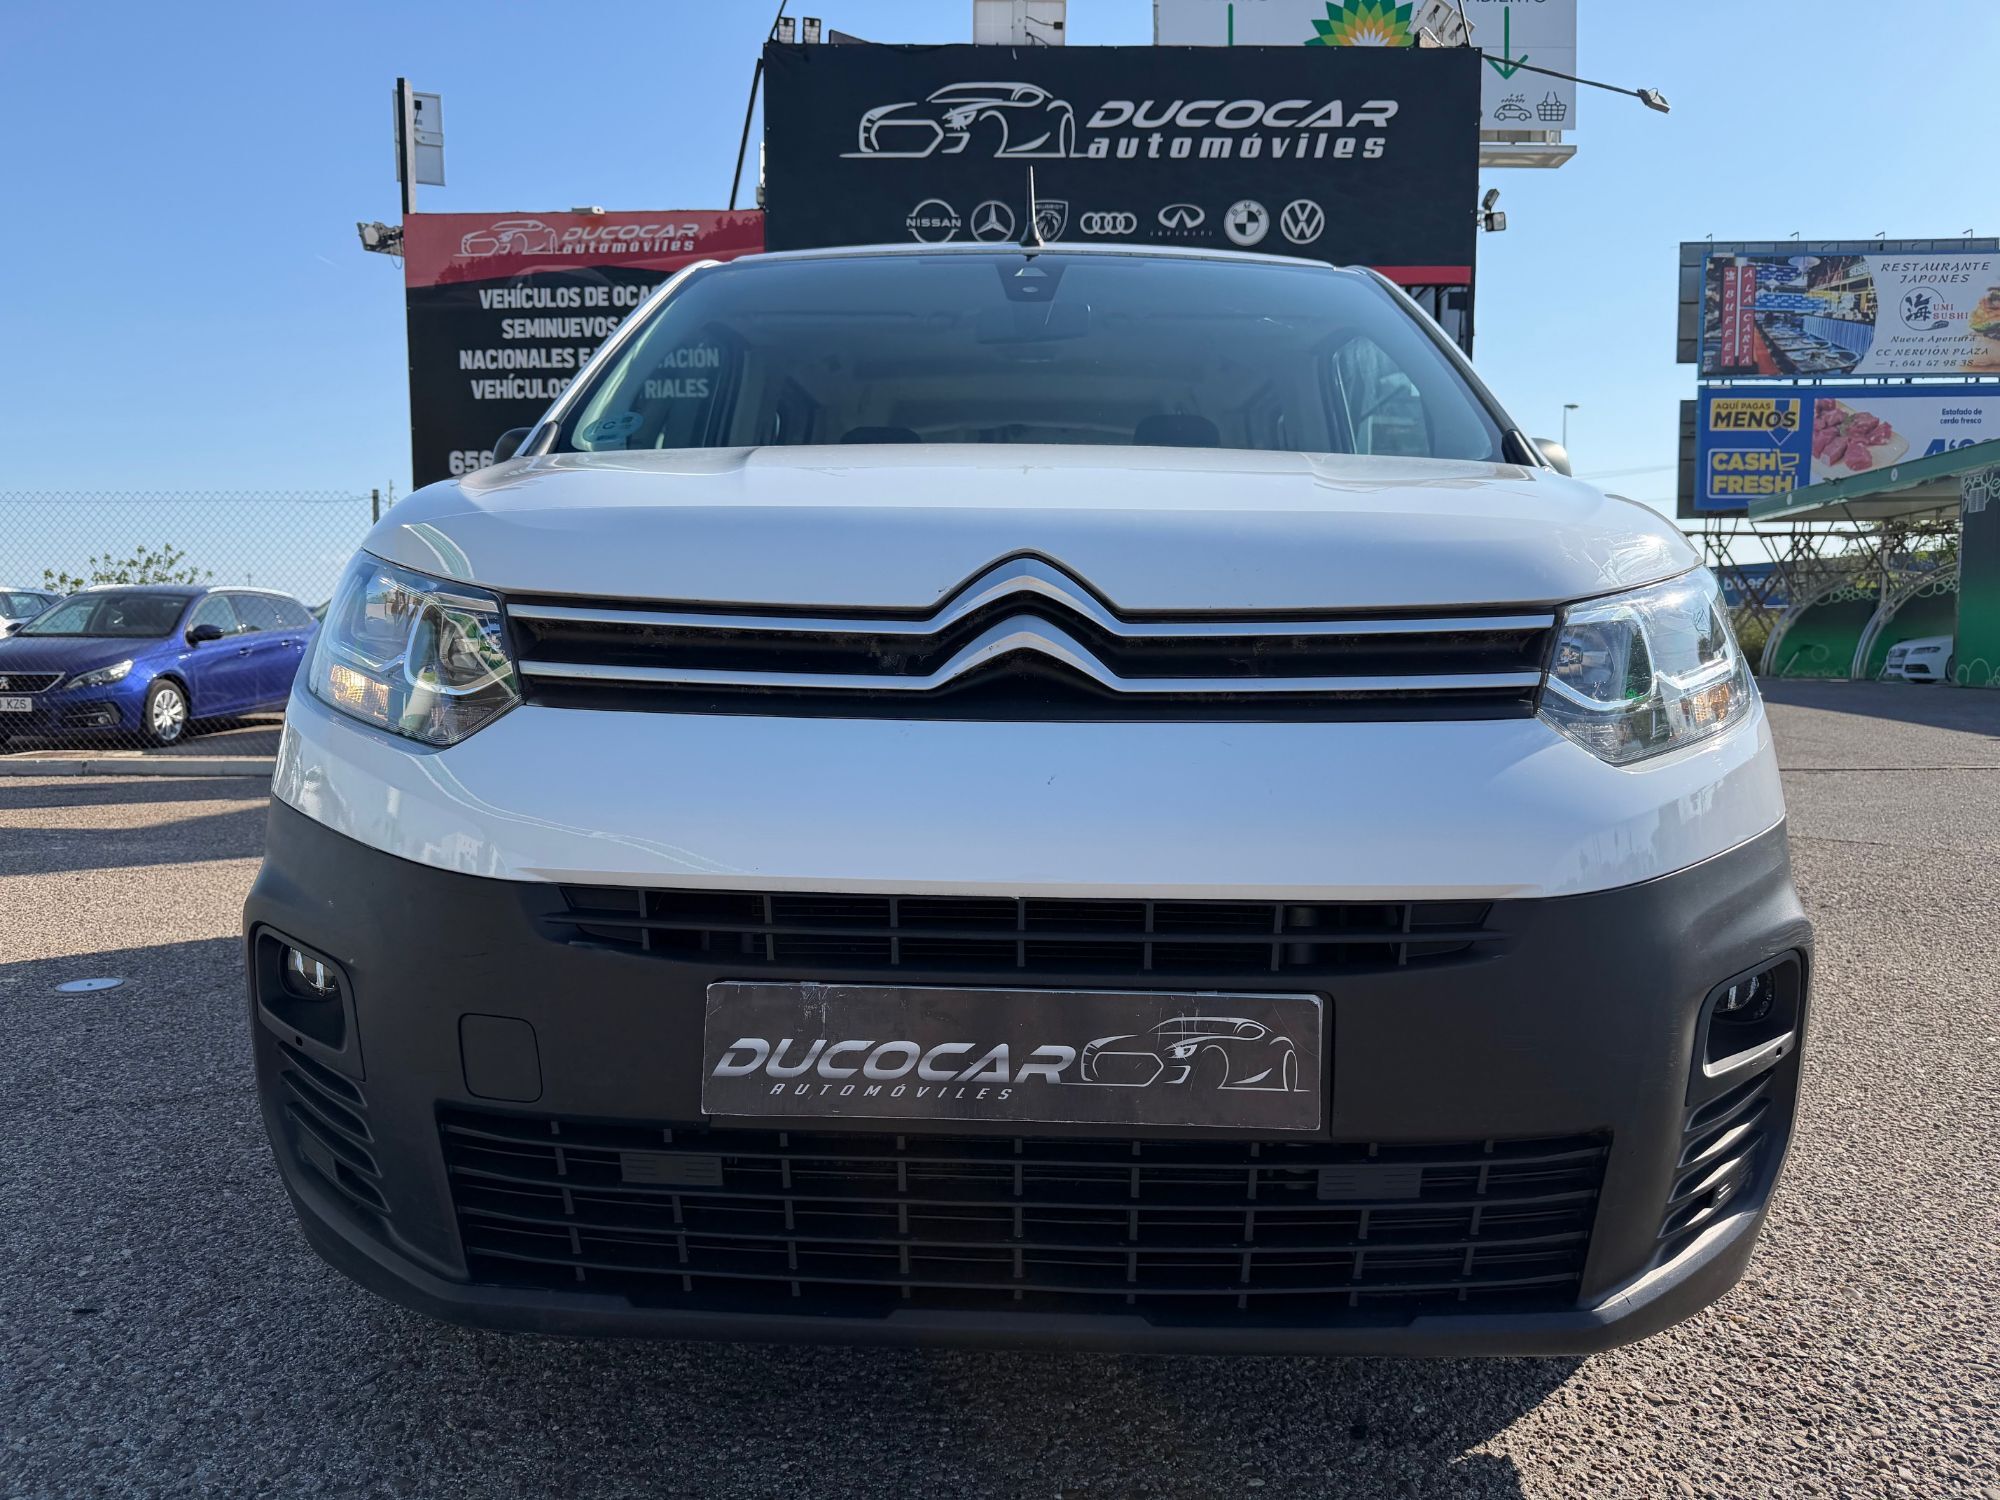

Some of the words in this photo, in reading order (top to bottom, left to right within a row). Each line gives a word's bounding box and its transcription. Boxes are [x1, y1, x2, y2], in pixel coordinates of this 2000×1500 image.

[1086, 99, 1399, 129] DUCOCAR
[1087, 131, 1386, 160] automóviles
[906, 218, 961, 228] NISSAN
[562, 223, 699, 241] DUCOCAR
[1880, 261, 1991, 272] RESTAURANTE
[1900, 274, 1970, 284] JAPONES
[479, 283, 582, 309] VEHÍCULOS
[584, 286, 609, 307] DE
[612, 285, 659, 307] OCA
[1932, 312, 1969, 320] SUSHI
[1933, 303, 1954, 312] UMI
[502, 316, 618, 340] SEMINUEVOS
[459, 347, 575, 371] NACIONALES
[1715, 401, 1738, 410] AQUÍ
[1741, 402, 1771, 410] PAGAS
[1713, 411, 1797, 428] MENOS
[1712, 453, 1777, 471] CASH
[1713, 475, 1793, 494] FRESH
[6, 698, 27, 709] KZS
[711, 1038, 1078, 1084] DUCOCAR
[769, 1083, 1013, 1100] AUTOMÓVILES
